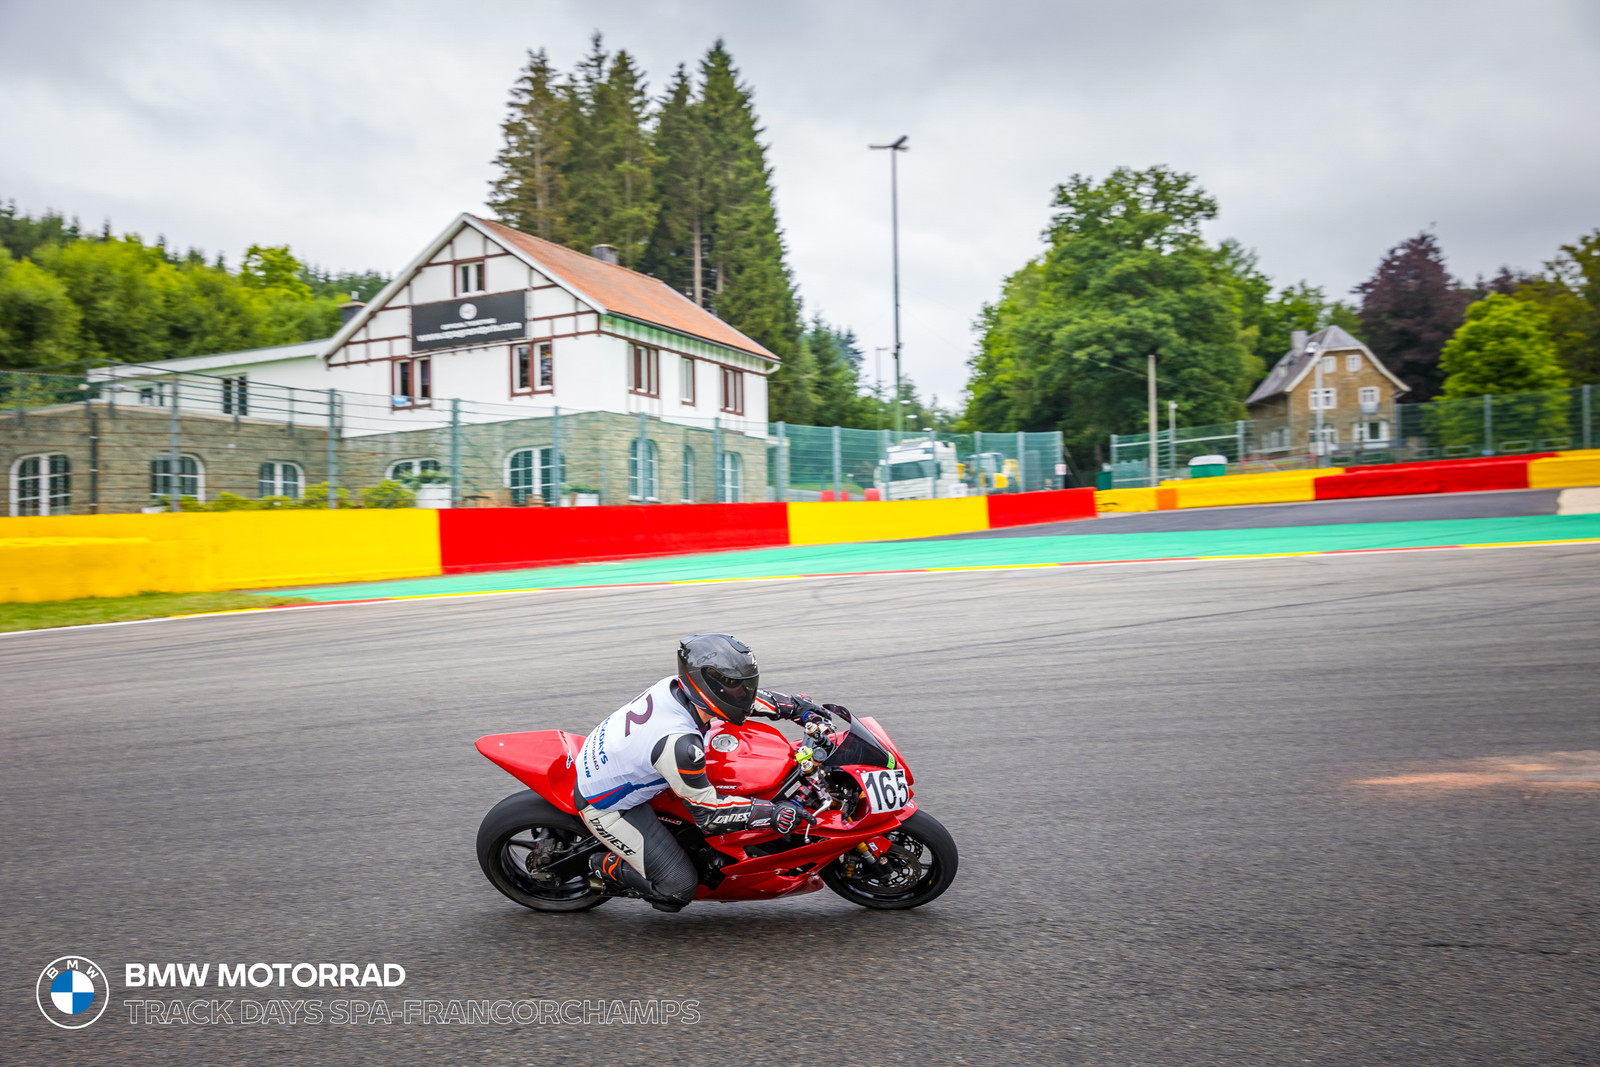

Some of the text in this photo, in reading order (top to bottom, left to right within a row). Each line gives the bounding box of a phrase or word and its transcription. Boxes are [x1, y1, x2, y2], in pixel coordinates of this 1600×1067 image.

[625, 690, 653, 737] 2
[865, 769, 909, 811] 165
[712, 811, 751, 825] DAINES
